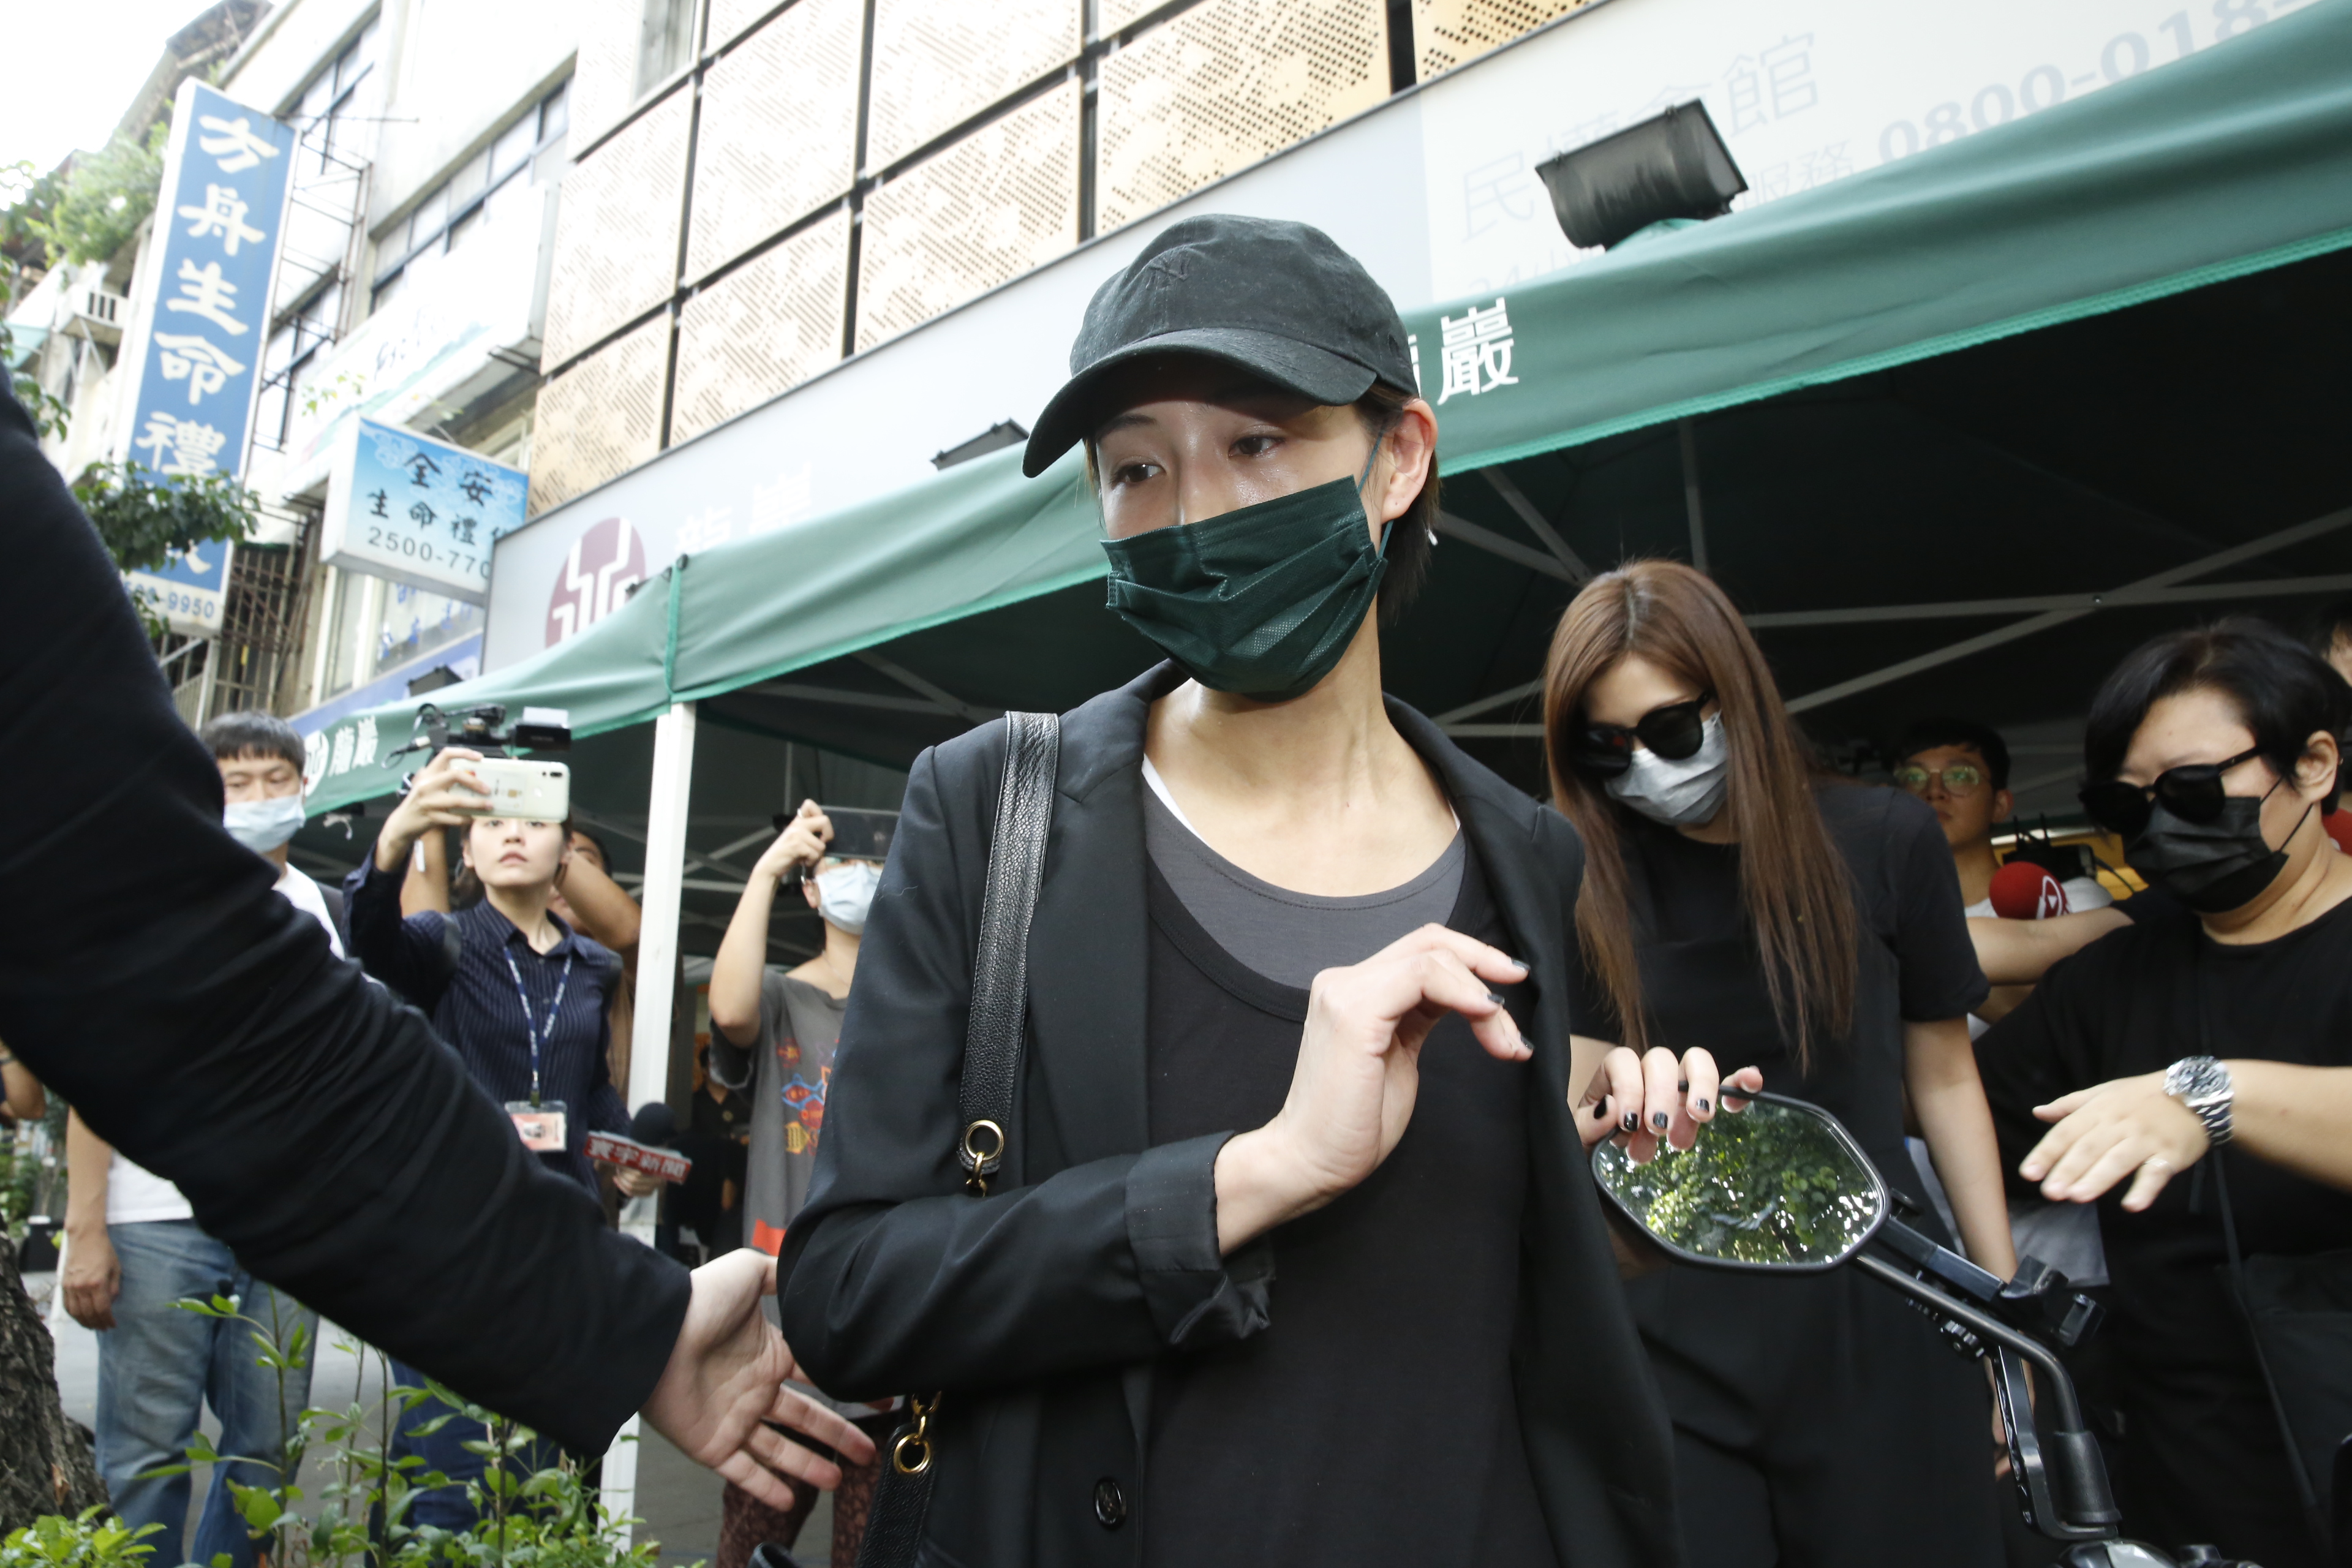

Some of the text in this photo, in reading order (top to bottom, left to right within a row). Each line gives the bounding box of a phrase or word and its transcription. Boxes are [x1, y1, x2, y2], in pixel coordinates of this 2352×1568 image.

[134, 115, 281, 575] 方舟生命禮
[1408, 296, 1519, 406] 巖
